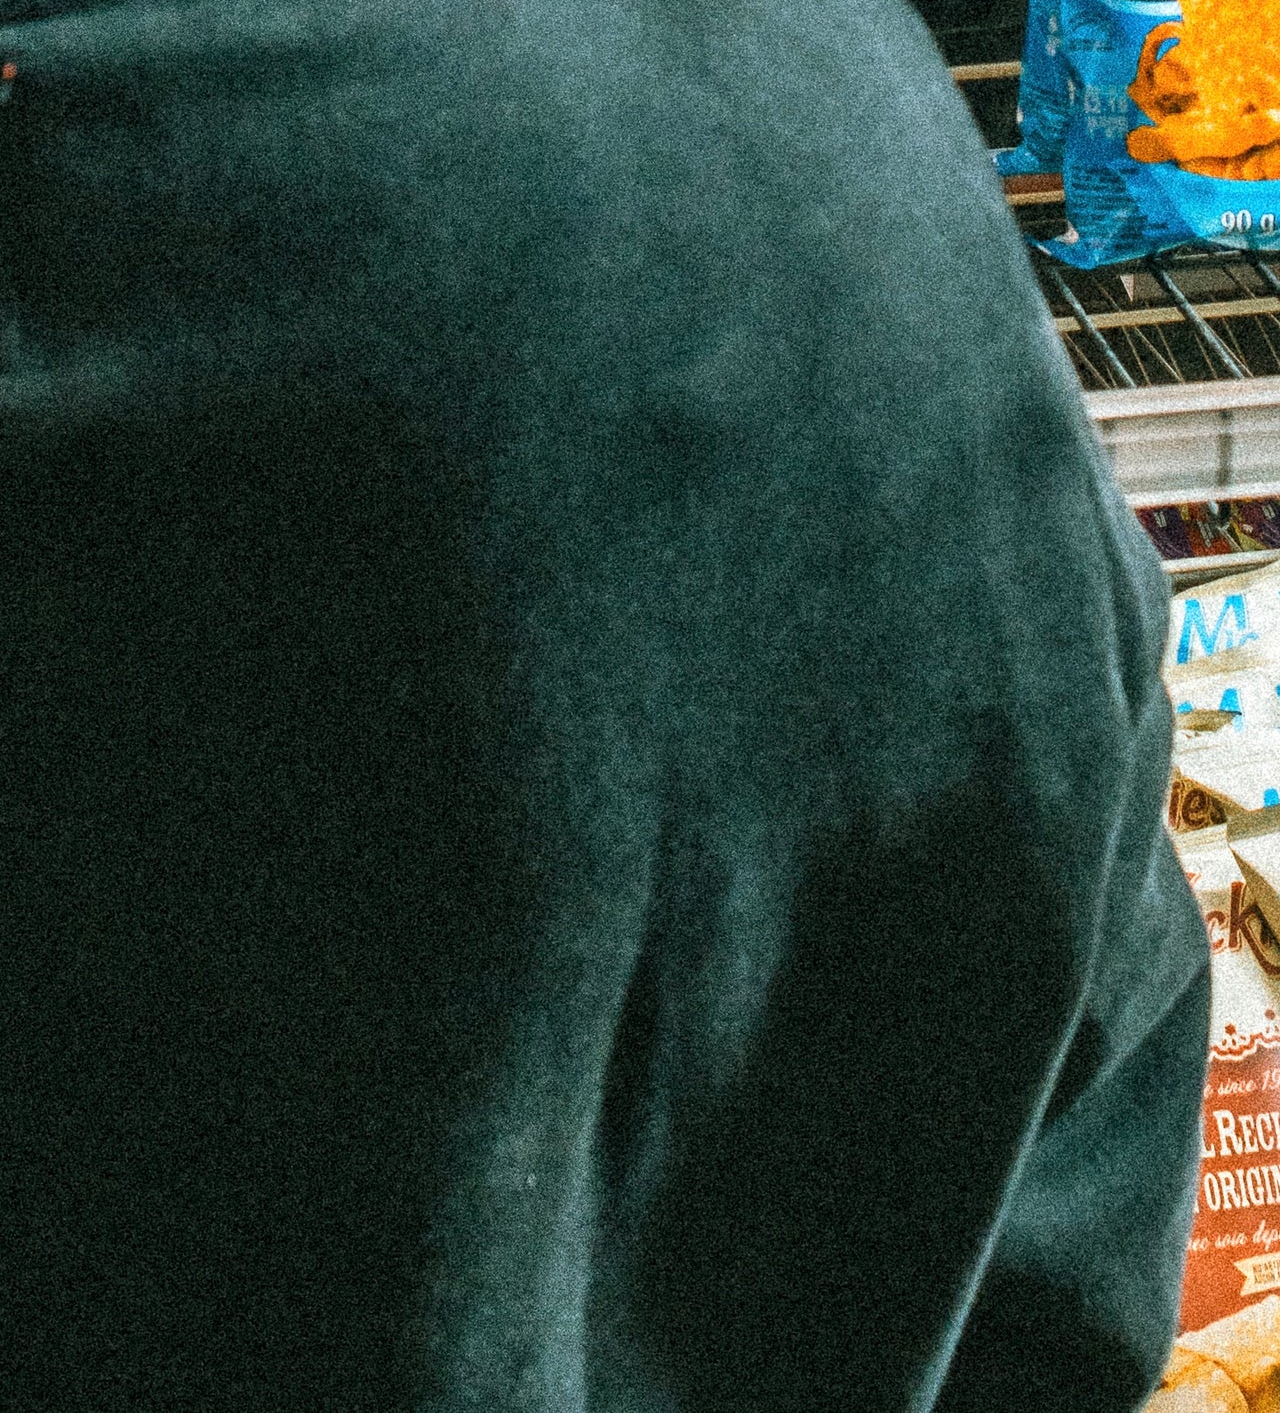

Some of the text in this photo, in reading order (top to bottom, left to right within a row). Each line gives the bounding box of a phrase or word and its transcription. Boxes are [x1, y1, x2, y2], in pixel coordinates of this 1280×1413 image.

[1220, 208, 1255, 235] 90
[1216, 1077, 1257, 1096] since
[1214, 1230, 1248, 1249] soin
